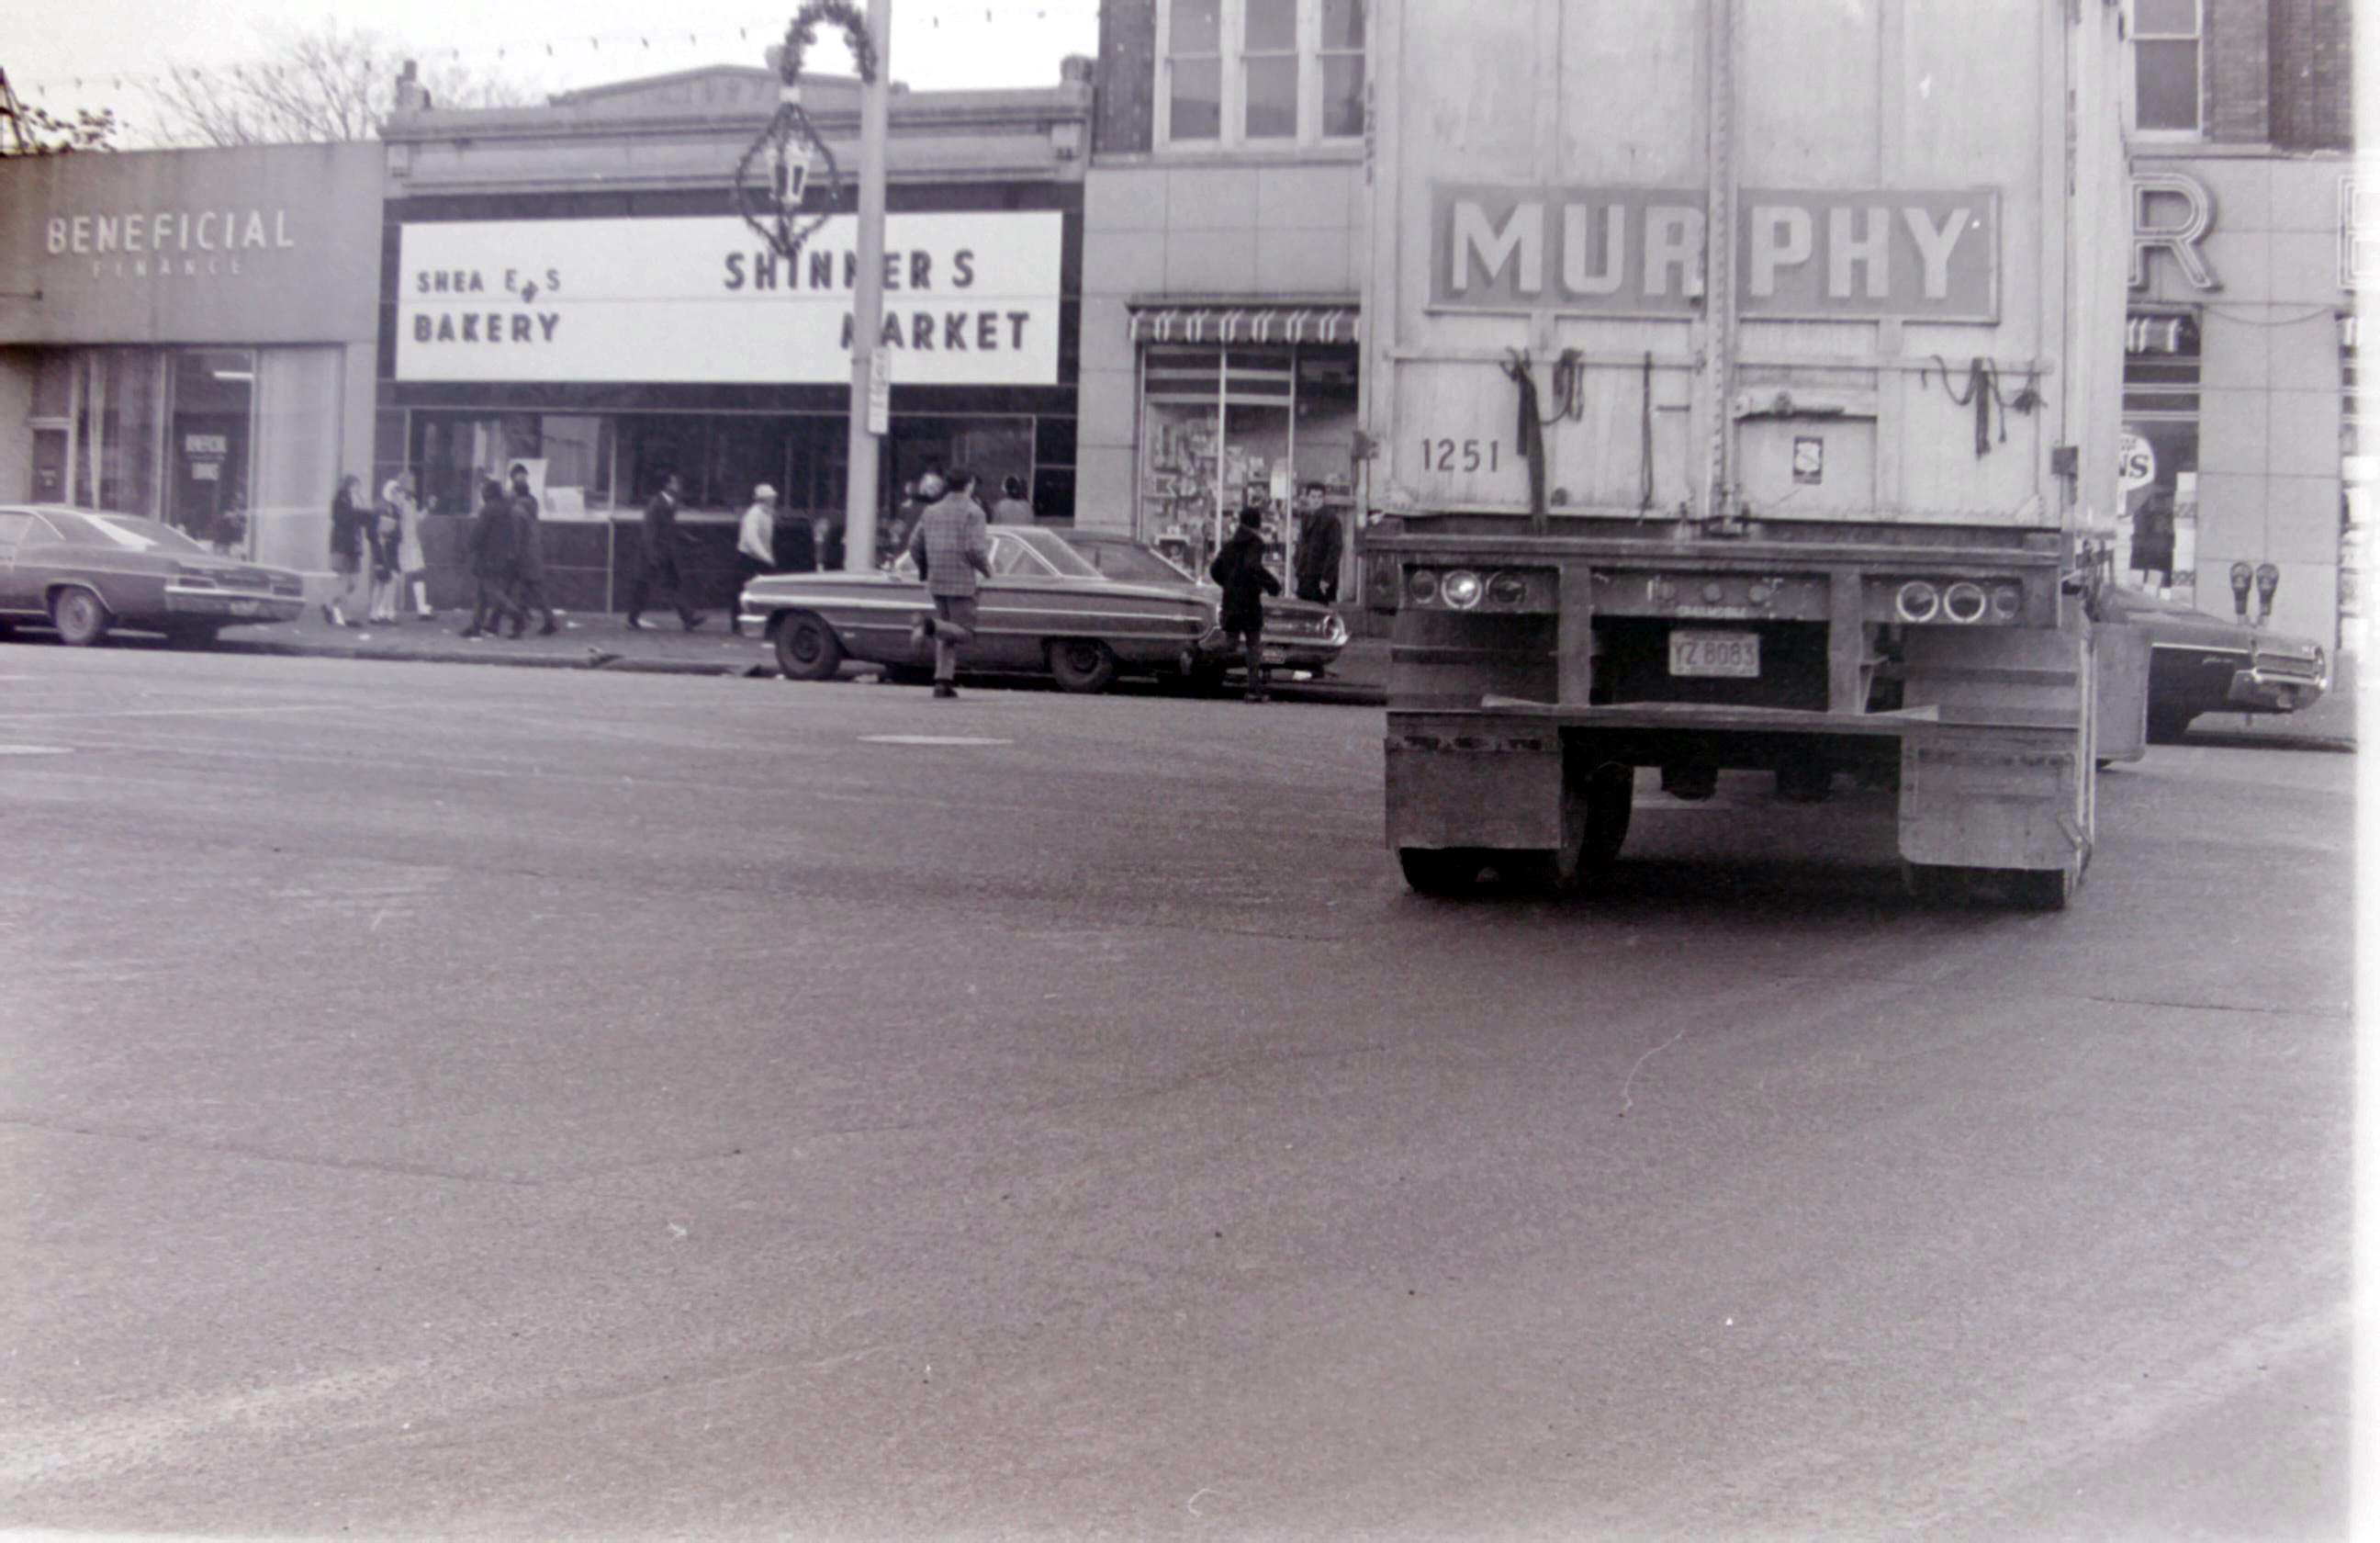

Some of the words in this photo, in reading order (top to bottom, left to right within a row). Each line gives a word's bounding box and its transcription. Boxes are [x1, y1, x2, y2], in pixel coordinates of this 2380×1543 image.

[46, 209, 295, 253] BENEFICIAL
[1452, 201, 1971, 298] MURPHY
[93, 256, 242, 277] FINANCE
[417, 271, 484, 293] SHEA
[413, 313, 560, 343] BAKERY
[1422, 438, 1499, 472] 1251
